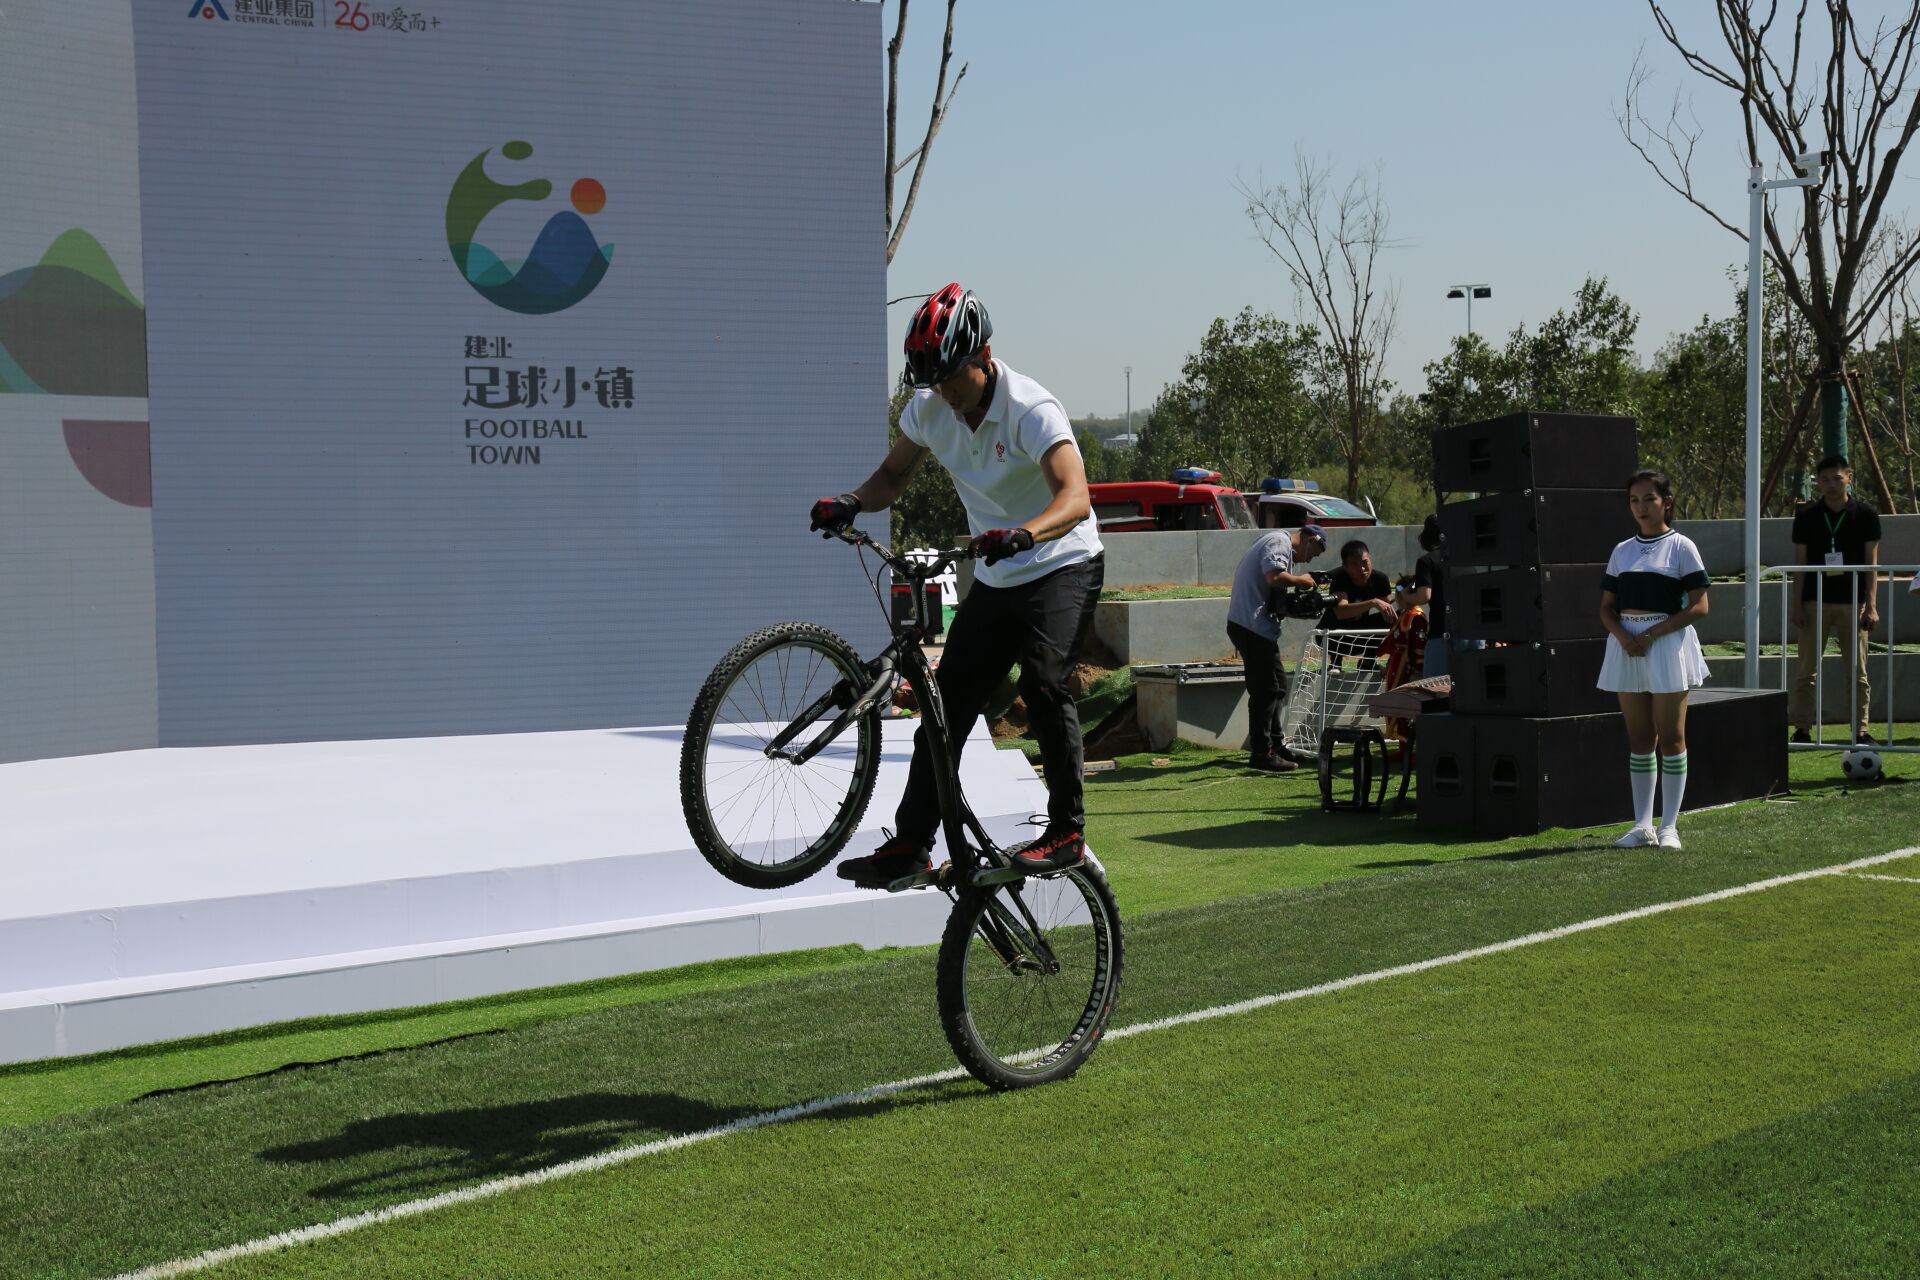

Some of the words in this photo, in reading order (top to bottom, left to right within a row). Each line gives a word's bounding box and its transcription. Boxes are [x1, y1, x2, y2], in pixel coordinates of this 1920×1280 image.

[235, 15, 280, 25] CENTRAL
[284, 18, 314, 28] CHINA
[335, 0, 369, 31] 26
[464, 335, 513, 359] 建业
[462, 366, 635, 409] 足球小镇
[465, 419, 588, 439] FOOTBALL
[466, 445, 541, 465] TOWN
